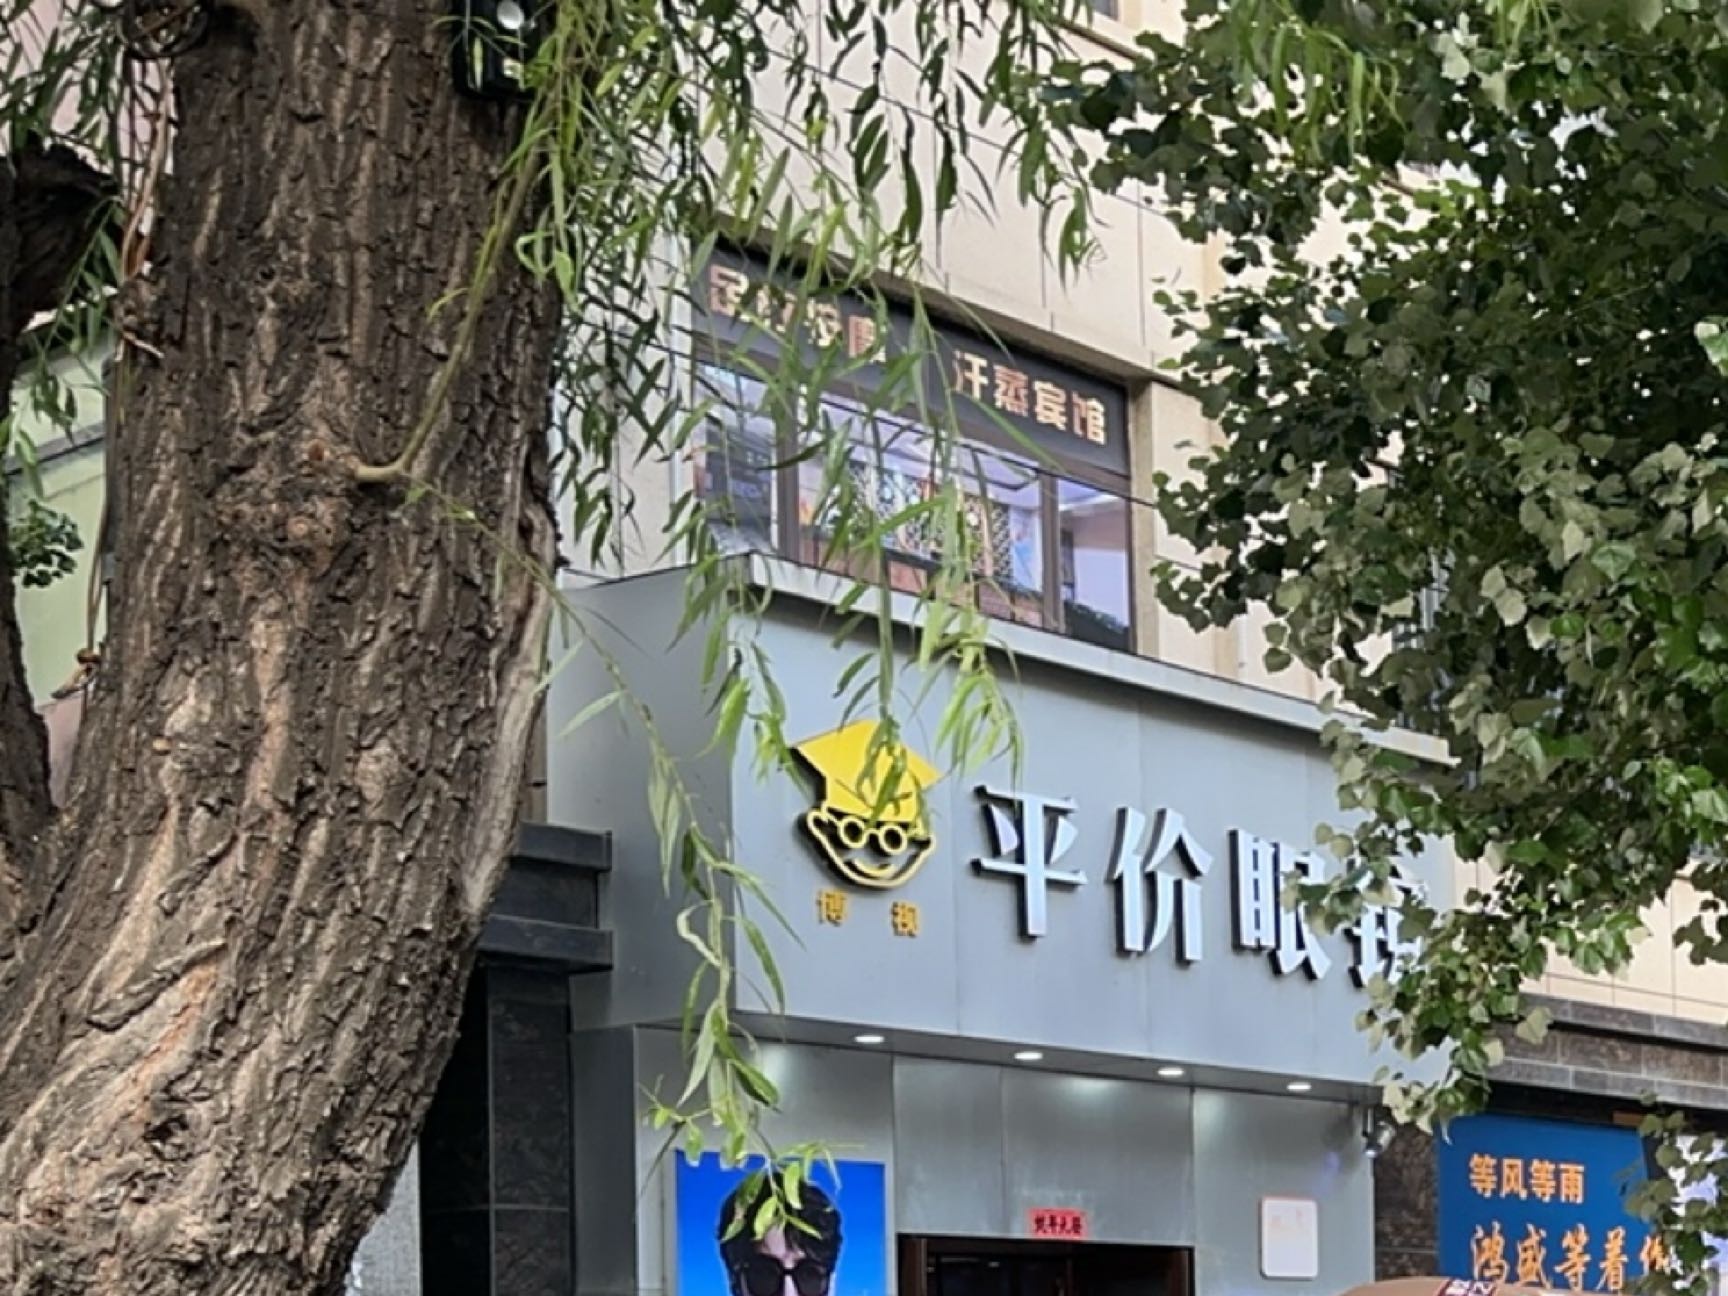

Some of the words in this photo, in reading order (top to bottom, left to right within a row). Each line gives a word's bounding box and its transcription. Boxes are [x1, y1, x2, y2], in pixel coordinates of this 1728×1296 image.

[953, 349, 1106, 445] 汗蒸宾馆
[1469, 1153, 1585, 1204] 等风等雨
